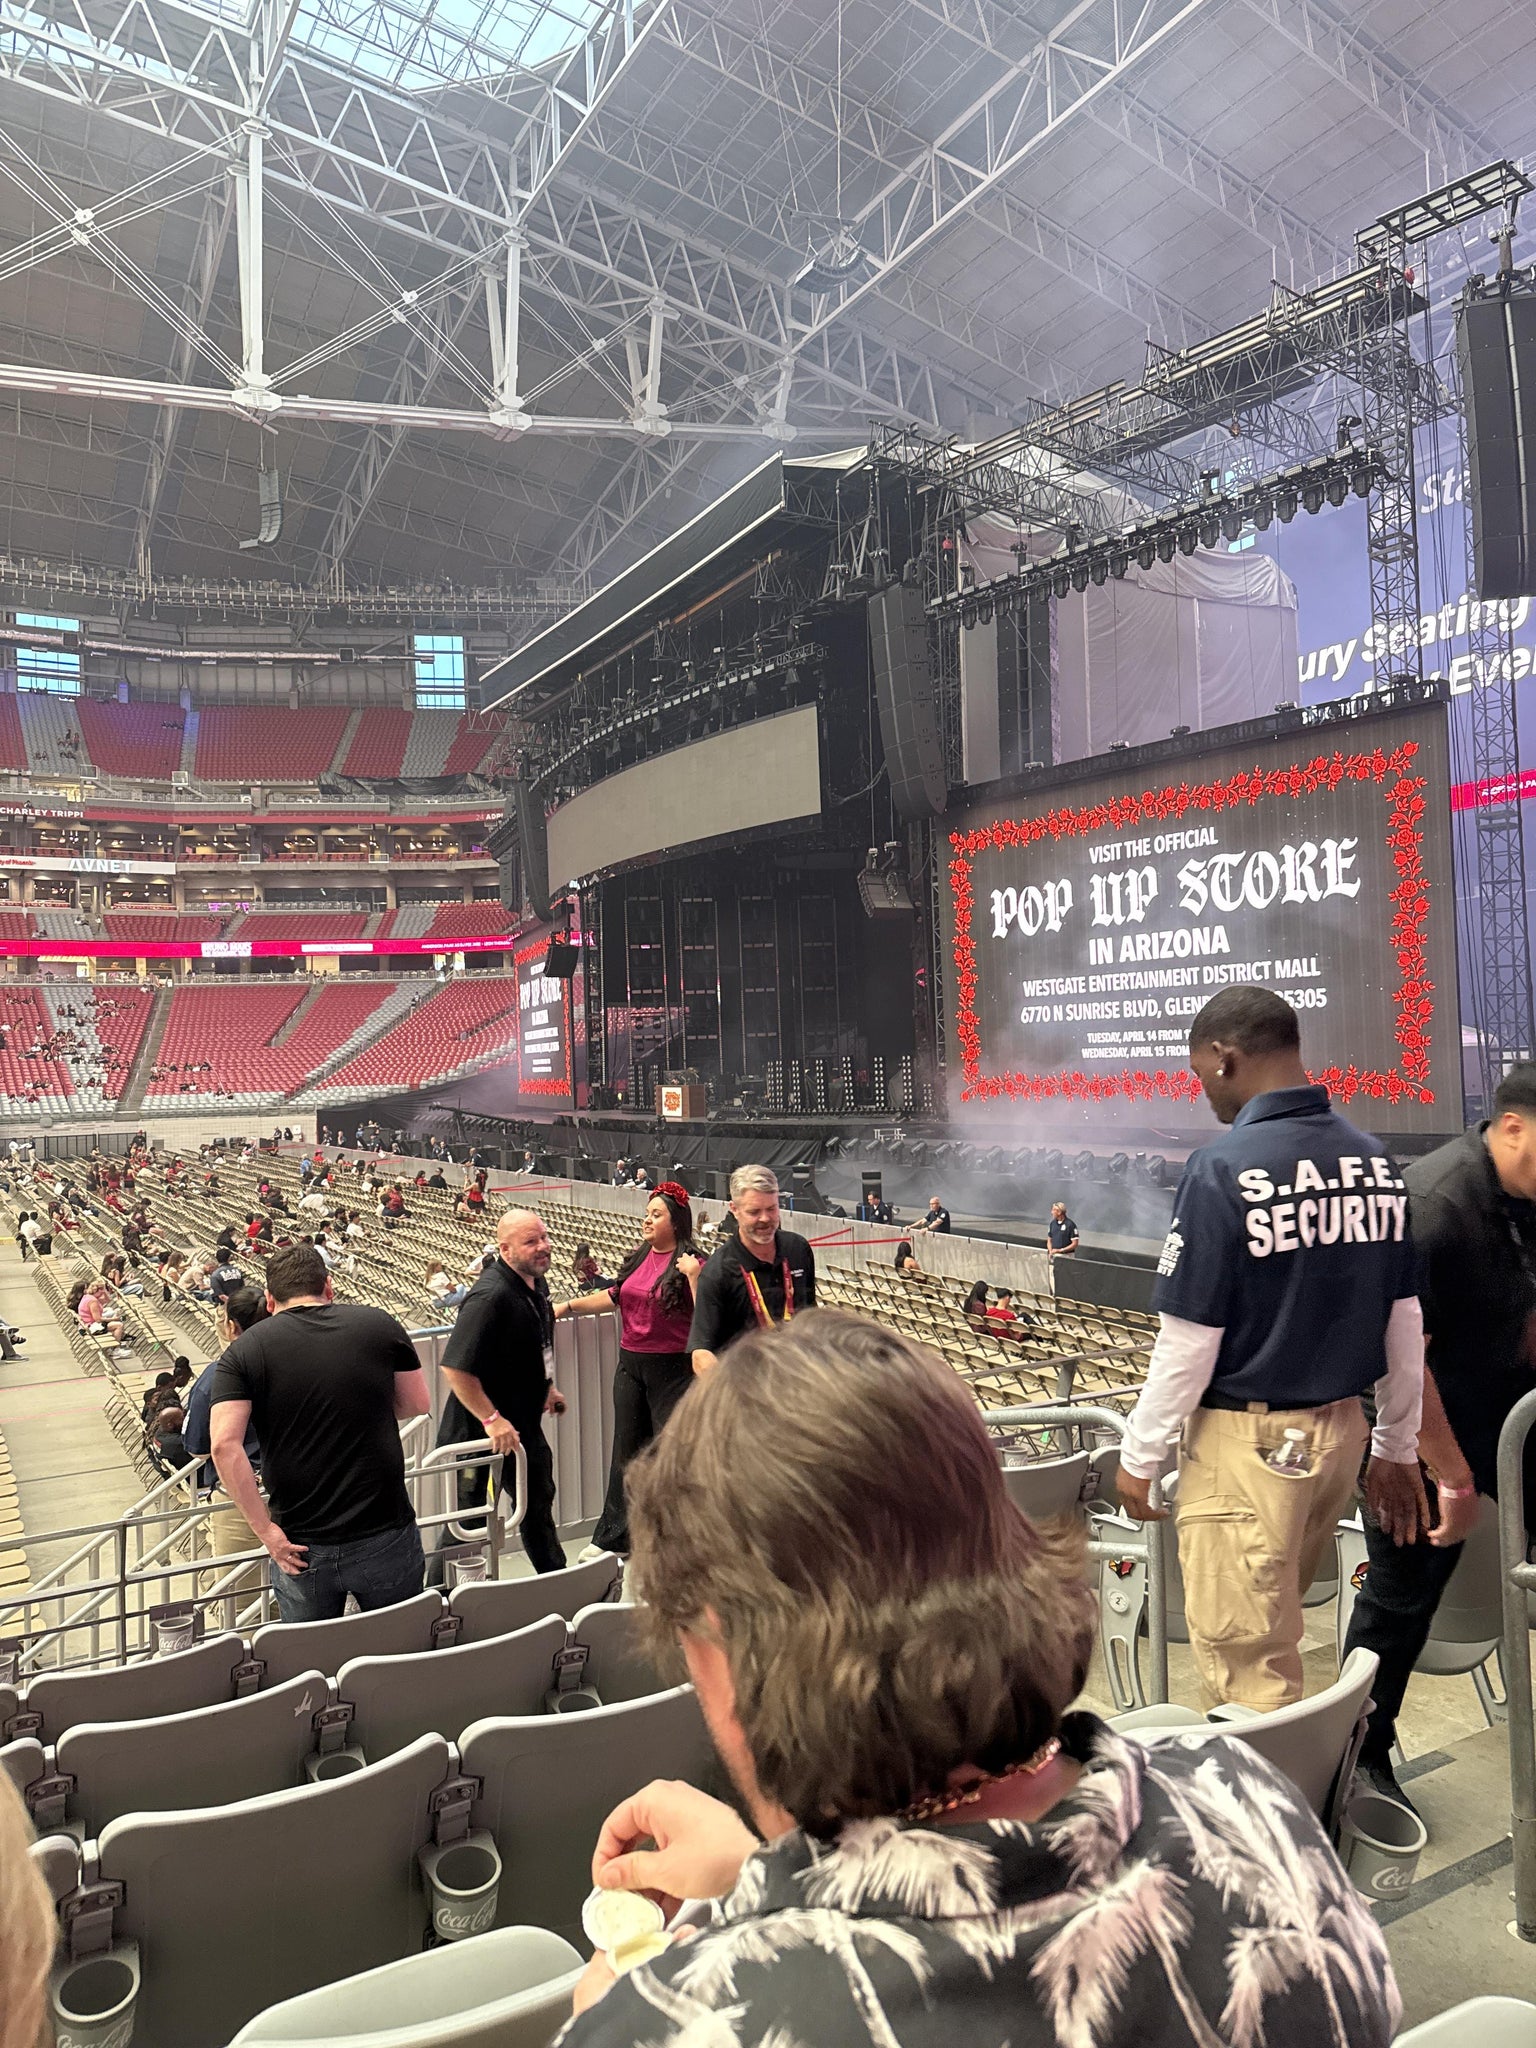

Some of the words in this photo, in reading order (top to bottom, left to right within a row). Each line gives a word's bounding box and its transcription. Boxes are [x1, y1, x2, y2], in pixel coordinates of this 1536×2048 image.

[1361, 594, 1529, 662] Seating
[0, 807, 48, 816] CHARLEY
[51, 810, 84, 818] TRIPPI
[1089, 844, 1122, 864] VISIT
[1124, 839, 1151, 860] THE
[1154, 827, 1219, 854] OFFICIAL
[69, 858, 133, 873] AVNET
[990, 878, 1074, 939] POP
[1089, 865, 1159, 927] UP
[1177, 836, 1361, 917] STORE
[1089, 938, 1113, 966] IN
[1119, 925, 1230, 963] ARIZONA
[1023, 976, 1086, 997] WESTGATE
[1089, 968, 1198, 992] ENTERTAINMENT
[1203, 960, 1271, 984] DISTRICT
[1275, 957, 1321, 978] MALL
[1020, 1004, 1051, 1024] 6770
[1053, 1004, 1063, 1022] N
[1065, 1000, 1120, 1021] SUNRISE
[1124, 997, 1161, 1018] BLVD,
[1165, 994, 1210, 1016] GLEN
[1275, 987, 1327, 1009] 5305
[1123, 1030, 1146, 1042] APRIL
[1147, 1030, 1157, 1041] 14
[1158, 1029, 1182, 1041] FROM
[1130, 1046, 1153, 1058] APRIL
[1166, 1045, 1191, 1057] FROM
[1238, 1156, 1405, 1202] S.A.F.E.
[1246, 1195, 1407, 1258] SECURITY
